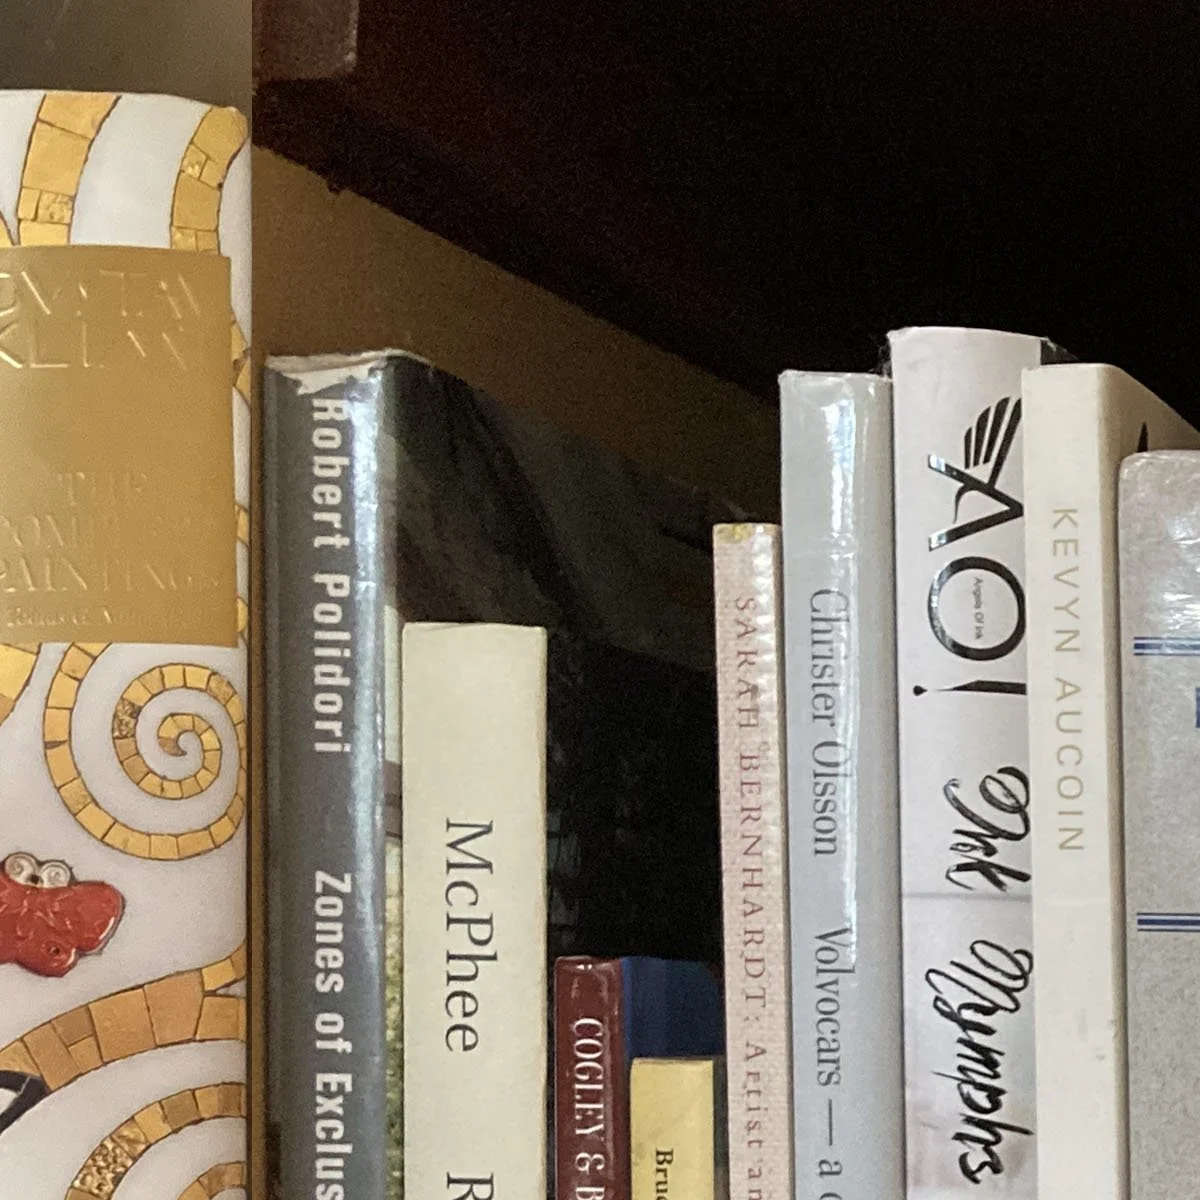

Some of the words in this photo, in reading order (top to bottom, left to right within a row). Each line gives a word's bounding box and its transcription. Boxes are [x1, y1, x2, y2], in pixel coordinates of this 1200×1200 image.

[313, 398, 351, 549] Robert
[1052, 508, 1081, 653] KEVYN
[313, 573, 351, 753] Polidori
[735, 597, 760, 729] SARAH
[811, 588, 850, 727] Christer
[812, 740, 852, 858] Olsson
[1055, 677, 1085, 852] AUCOIN
[314, 870, 352, 993] Zones
[445, 818, 498, 1052] McPhee
[739, 752, 766, 1022] BERNHARDT:
[314, 1012, 353, 1053] of
[573, 1018, 605, 1135] COGLEY
[814, 927, 856, 1087] Volvocars
[925, 940, 1034, 1184] Nymphs
[575, 1152, 605, 1172] &
[745, 1041, 767, 1149] Artist
[819, 1159, 843, 1178] a
